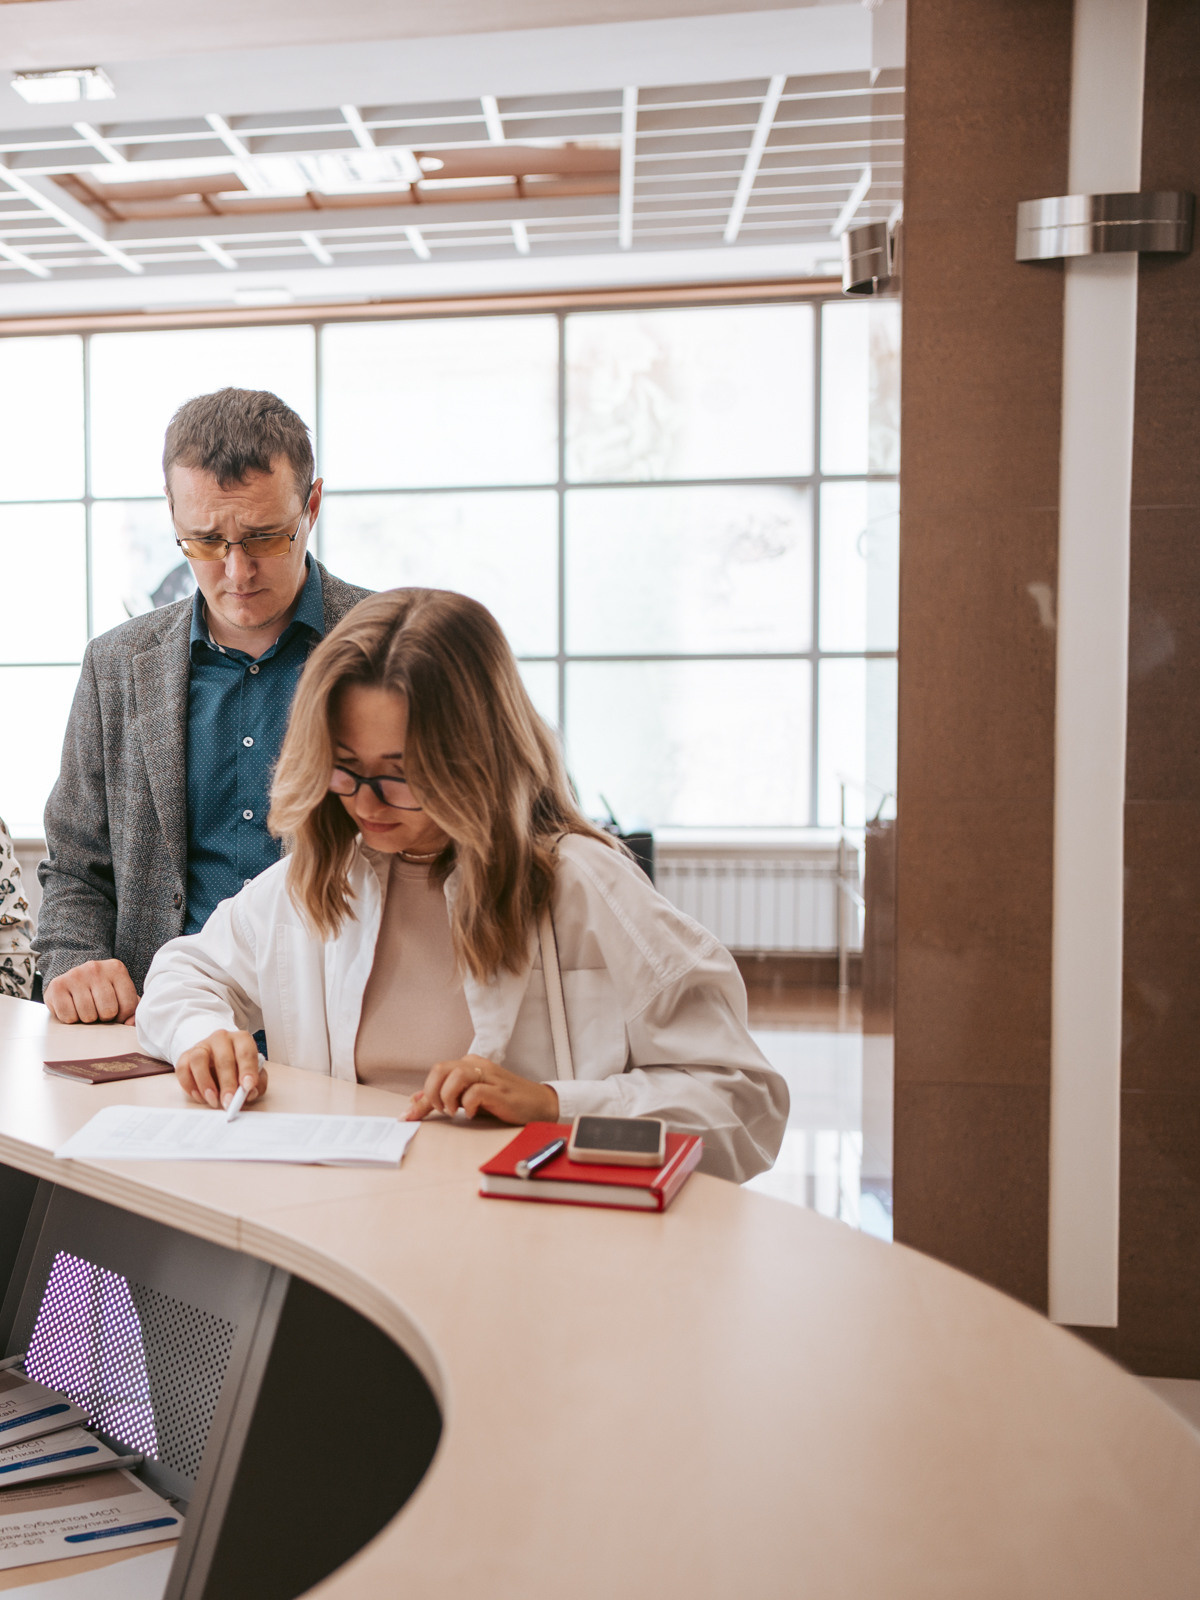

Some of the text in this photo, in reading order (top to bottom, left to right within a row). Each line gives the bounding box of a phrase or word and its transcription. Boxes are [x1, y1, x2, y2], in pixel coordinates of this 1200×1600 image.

[17, 1440, 45, 1452] МСП
[23, 1514, 88, 1530] субъектов
[90, 1507, 122, 1518] МСП
[59, 1517, 120, 1532] закупкам
